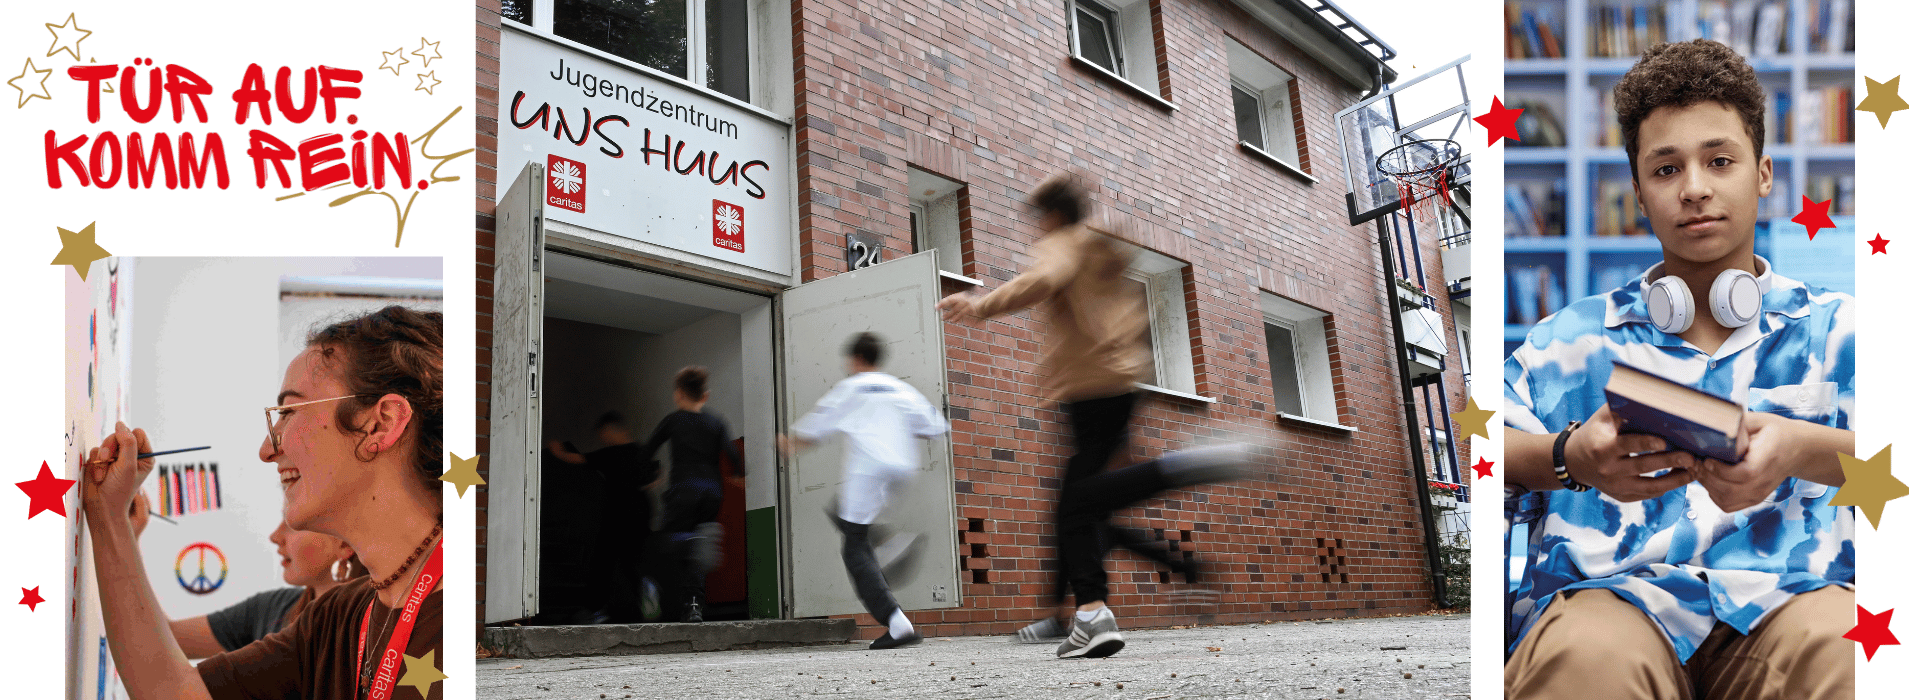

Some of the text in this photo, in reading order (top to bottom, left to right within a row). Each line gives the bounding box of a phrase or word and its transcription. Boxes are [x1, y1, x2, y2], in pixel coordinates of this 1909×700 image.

[549, 58, 739, 140] Jugendzentrum
[510, 90, 770, 200] UNS HUUS
[549, 195, 583, 211] caritas
[715, 236, 743, 251] caritas
[853, 241, 882, 270] 24
[401, 573, 433, 623] caritas
[372, 648, 398, 700] caritas
